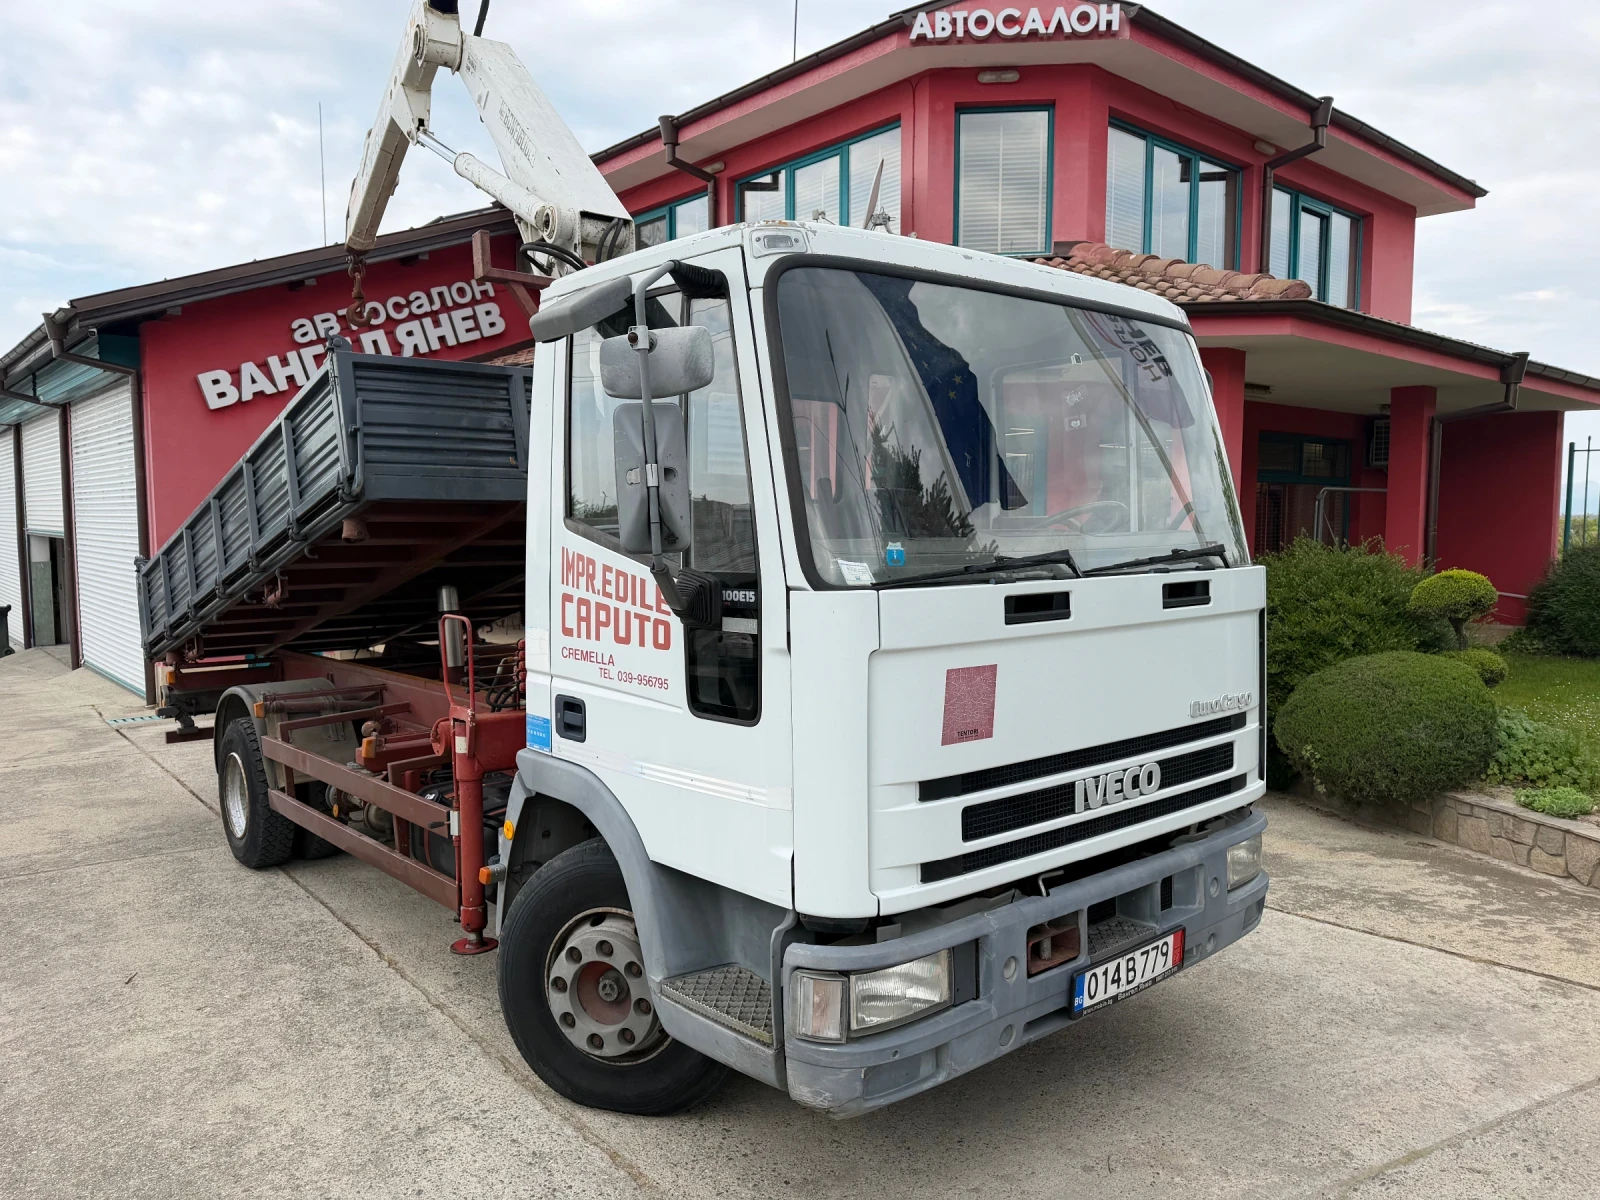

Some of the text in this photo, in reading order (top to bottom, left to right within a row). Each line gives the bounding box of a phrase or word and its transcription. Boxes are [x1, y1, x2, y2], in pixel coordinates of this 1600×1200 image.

[909, 4, 1121, 42] АВТОСАЛОН
[197, 302, 506, 410] ВАНГЛ ЯНЕВ
[722, 590, 756, 603] 100E15
[561, 592, 672, 651] CAPUTO
[561, 646, 615, 666] CREMELLA
[599, 667, 669, 690] TEL. 039-956795
[1190, 691, 1252, 718] EuroCargo
[957, 728, 979, 737] TENTORI
[1075, 762, 1161, 814] IVECO
[1074, 995, 1084, 1006] BG
